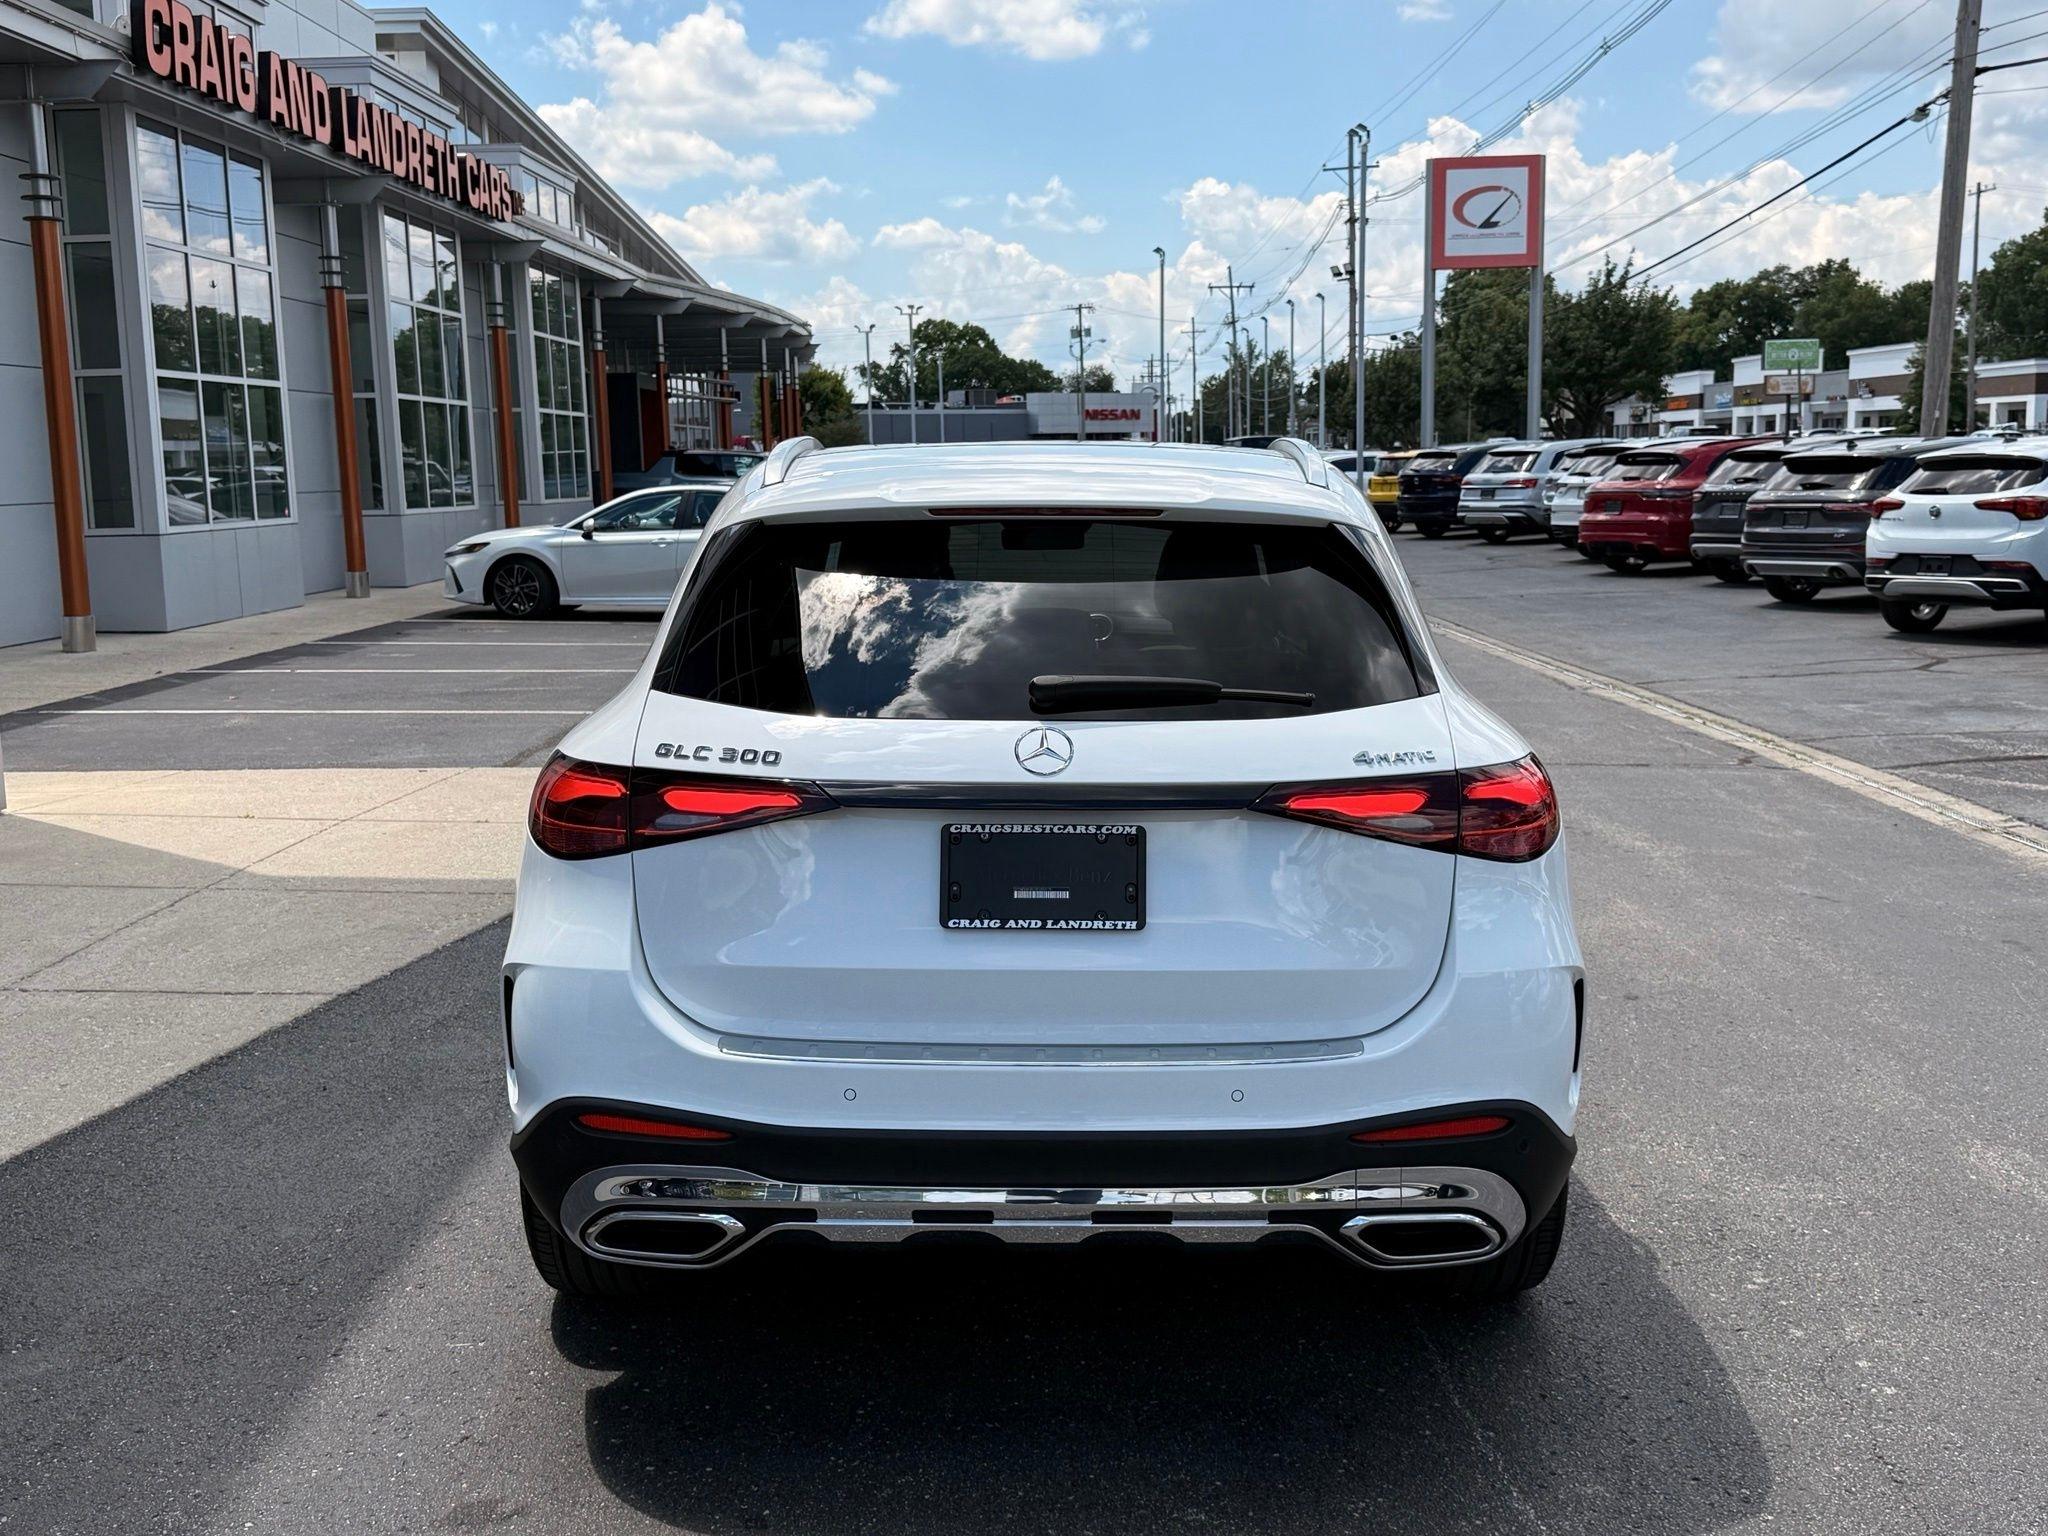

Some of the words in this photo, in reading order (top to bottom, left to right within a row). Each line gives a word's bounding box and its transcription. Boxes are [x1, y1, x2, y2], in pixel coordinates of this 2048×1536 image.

[144, 0, 256, 113] CRAIG
[270, 51, 332, 146] AND
[340, 88, 460, 202] LANDRETH
[466, 152, 512, 223] CARS
[1084, 409, 1141, 421] NISSAN
[655, 743, 713, 761] GLC
[718, 747, 782, 766] 300
[1352, 750, 1437, 768] 4MATIC
[949, 824, 1138, 835] CRAIGSBESTCARS.COM
[947, 919, 1001, 929] CRAIG
[1005, 919, 1042, 929] AND
[1045, 920, 1138, 930] LANDRETH
